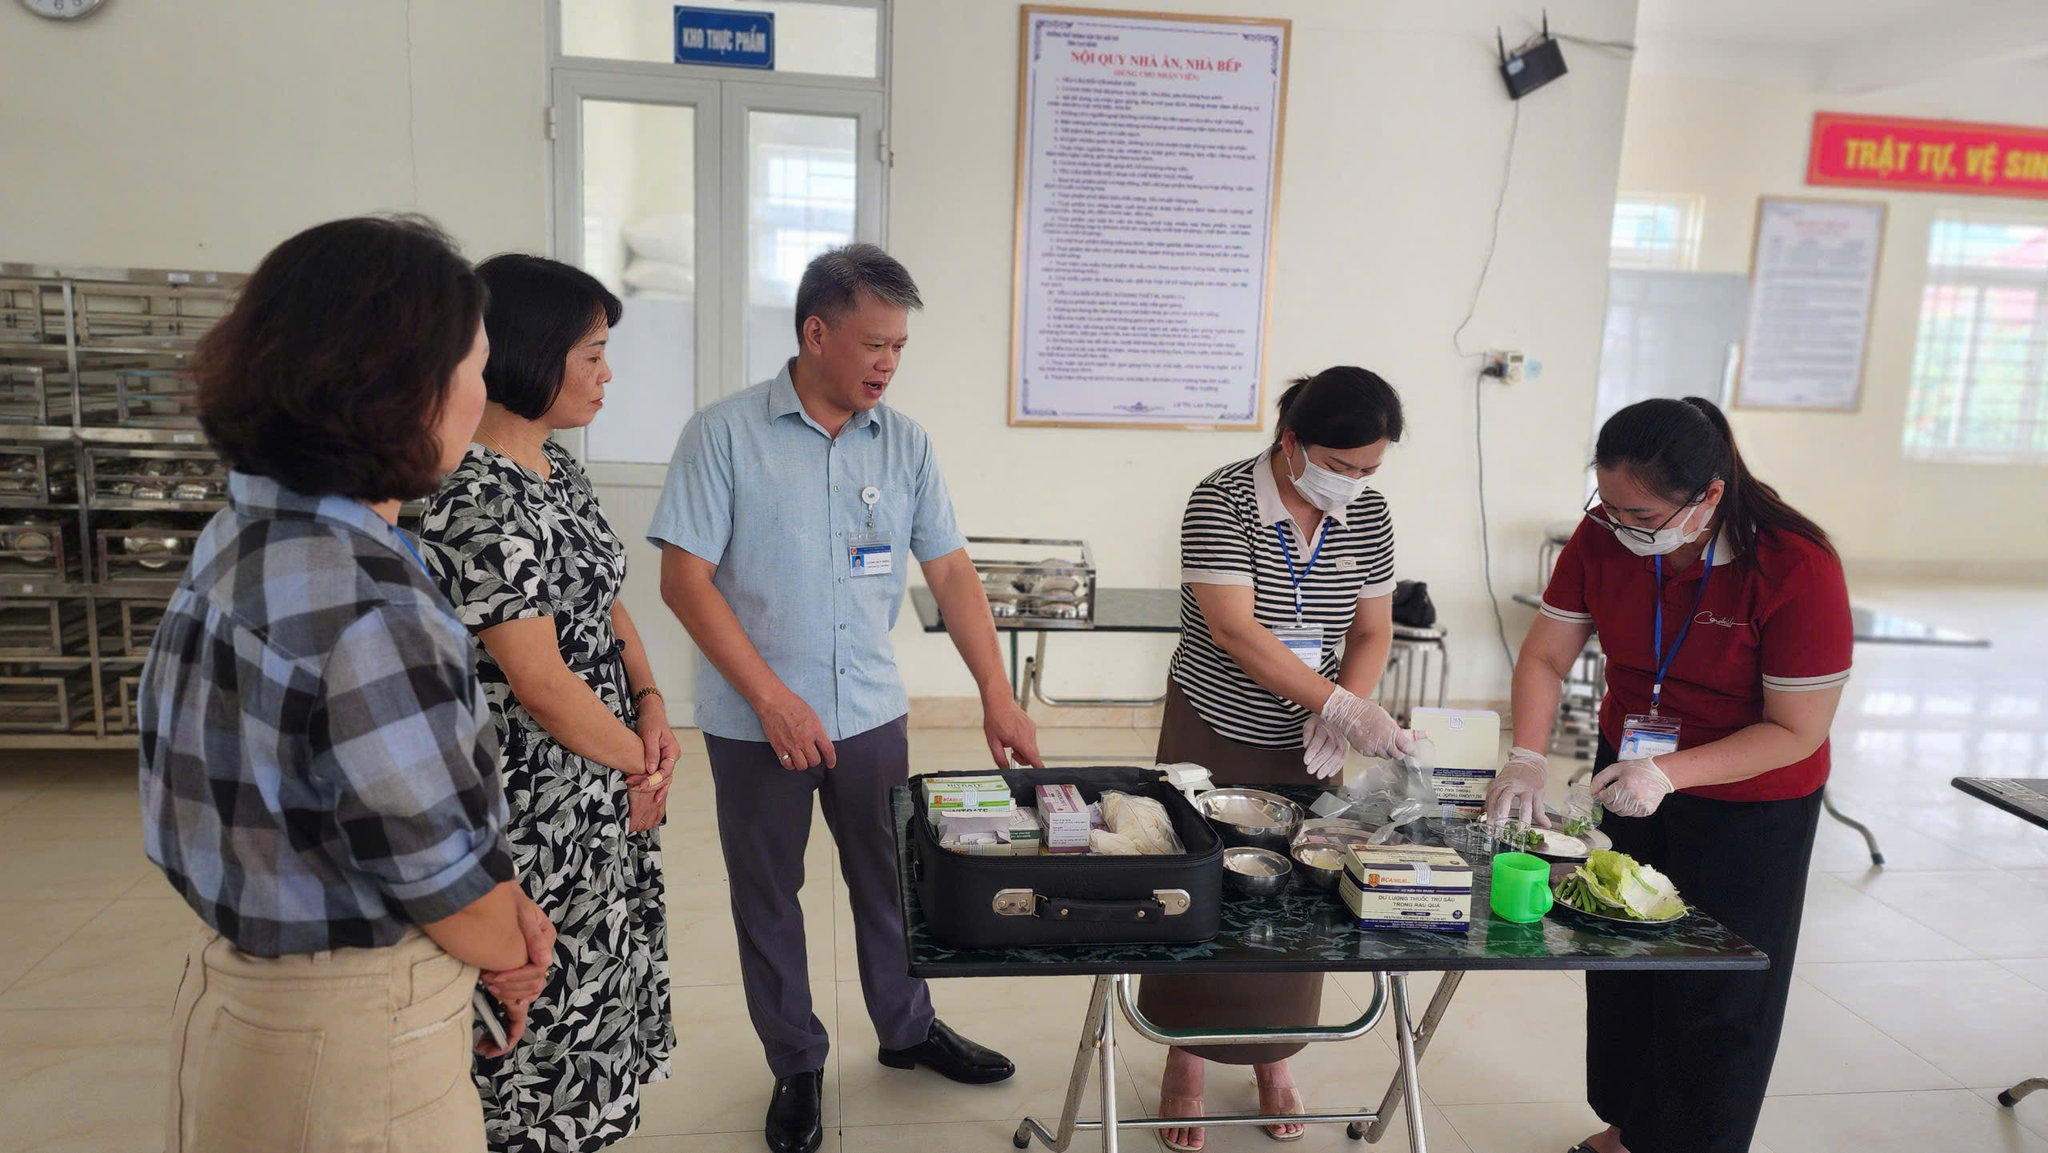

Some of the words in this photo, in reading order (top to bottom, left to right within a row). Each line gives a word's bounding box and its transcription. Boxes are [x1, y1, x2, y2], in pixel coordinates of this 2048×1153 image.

[682, 27, 705, 48] KHO
[706, 28, 733, 55] THỰC
[735, 24, 766, 53] PHẨM
[1070, 49, 1094, 66] NỘI
[1098, 53, 1126, 67] QUY
[1130, 53, 1158, 67] NHÀ
[1186, 57, 1212, 72] NHÀ
[1217, 57, 1242, 73] BẾP
[1845, 135, 1911, 176] TRẬT
[1918, 142, 1957, 181] TỰ,
[1965, 142, 1999, 183] VỆ
